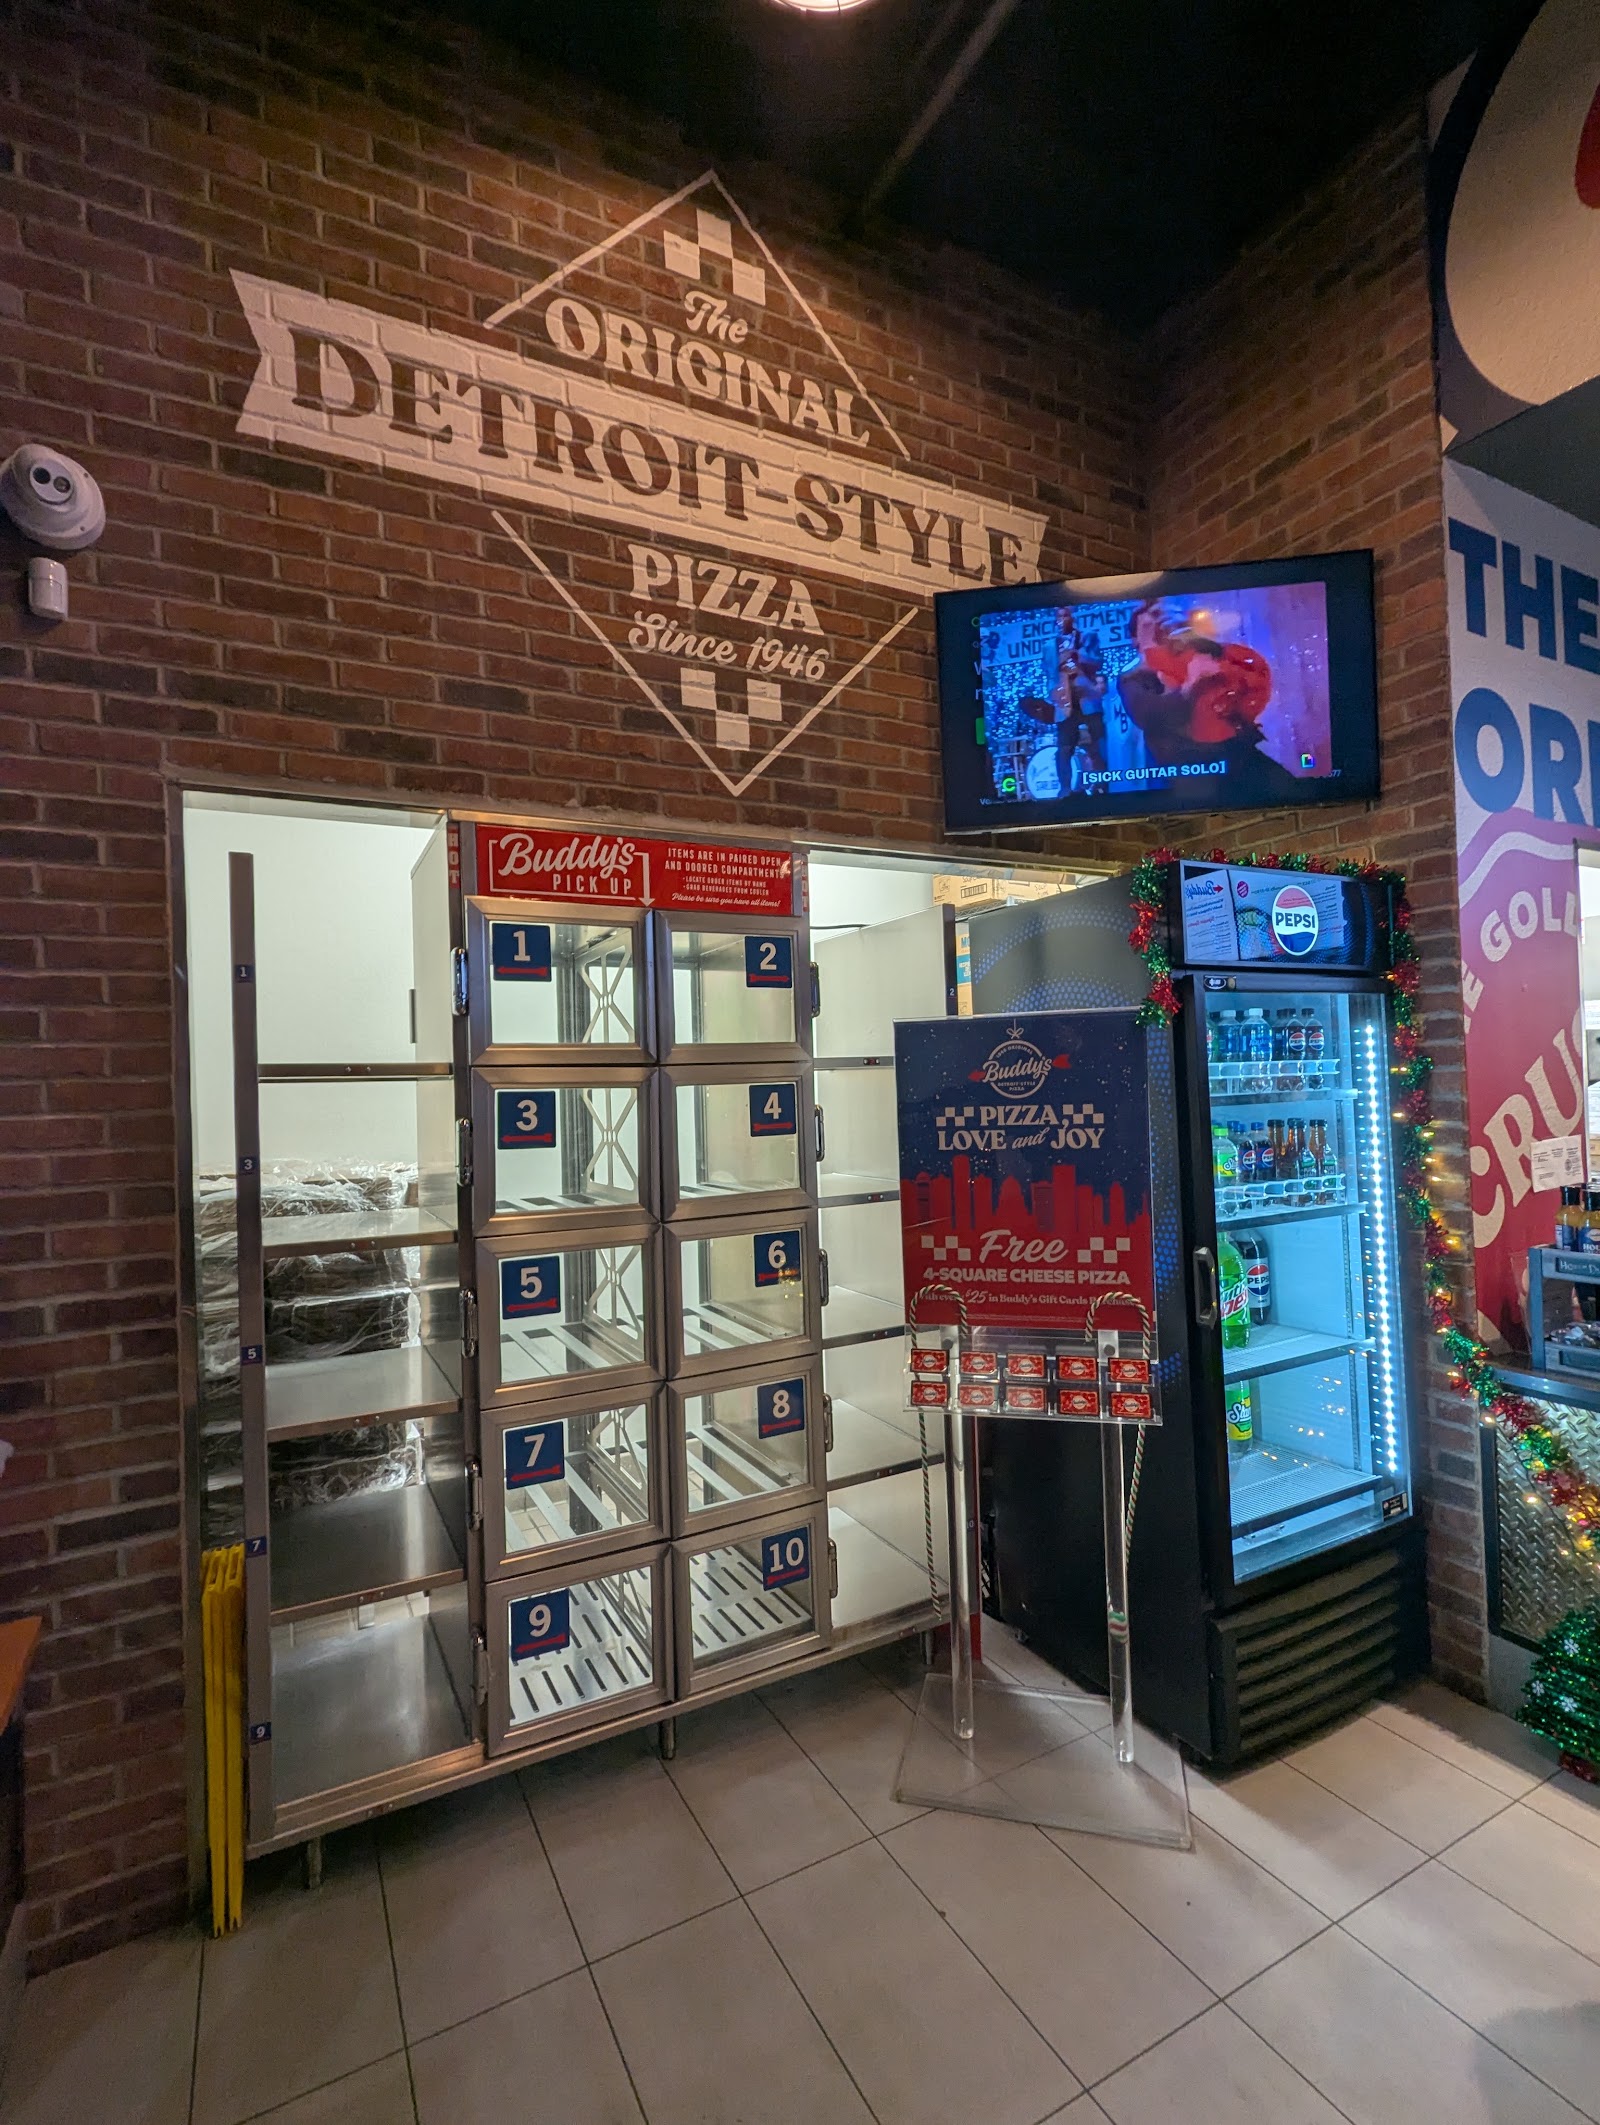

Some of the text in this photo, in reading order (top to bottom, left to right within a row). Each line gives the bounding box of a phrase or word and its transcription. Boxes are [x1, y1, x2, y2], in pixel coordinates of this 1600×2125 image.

[684, 290, 749, 343] The
[545, 298, 870, 448] ORIGINAL
[288, 327, 1026, 587] DETROIT-STYLE
[628, 543, 825, 636] PIZZA
[1448, 516, 1600, 675] THE
[628, 610, 829, 682] Since 1946
[1082, 760, 1226, 784] [SICK GUITAR SOLO]
[498, 832, 636, 879] Buddy's
[668, 847, 781, 867] ITEMS ARE IN PAIRED OPEN
[664, 860, 785, 879] AND DOORED COMPARTMENTS
[553, 873, 632, 895] PICK UP
[671, 892, 695, 902] Please
[696, 894, 705, 902] be
[705, 896, 721, 904] sure
[720, 897, 734, 906] you
[734, 896, 750, 905] have
[1275, 911, 1316, 929] PEPSI
[513, 930, 531, 961] 1
[759, 943, 777, 970] 2
[239, 966, 247, 977] 1
[950, 988, 955, 996] 2
[982, 1056, 1053, 1083] Buddy's
[515, 1100, 538, 1131] 3
[762, 1092, 782, 1120] 4
[980, 1104, 1069, 1131] PIZZA,
[938, 1127, 1105, 1151] LOVE and JOY
[244, 1158, 253, 1170] 3
[768, 1240, 787, 1269] 6
[979, 1229, 1069, 1264] Free
[520, 1267, 542, 1300] 5
[923, 1267, 1131, 1285] 4-SQUARE CHEESE PIZZA
[965, 1288, 988, 1304] $25
[989, 1293, 999, 1303] in
[1000, 1294, 1038, 1305] Buddy's
[1039, 1295, 1058, 1304] Gift
[1059, 1296, 1088, 1305] Cards
[247, 1347, 257, 1360] 5
[772, 1389, 791, 1419] 8
[523, 1433, 546, 1467] 7
[252, 1539, 261, 1552] 7
[769, 1537, 804, 1571] 10
[529, 1603, 552, 1637] 9
[256, 1726, 265, 1739] 9
